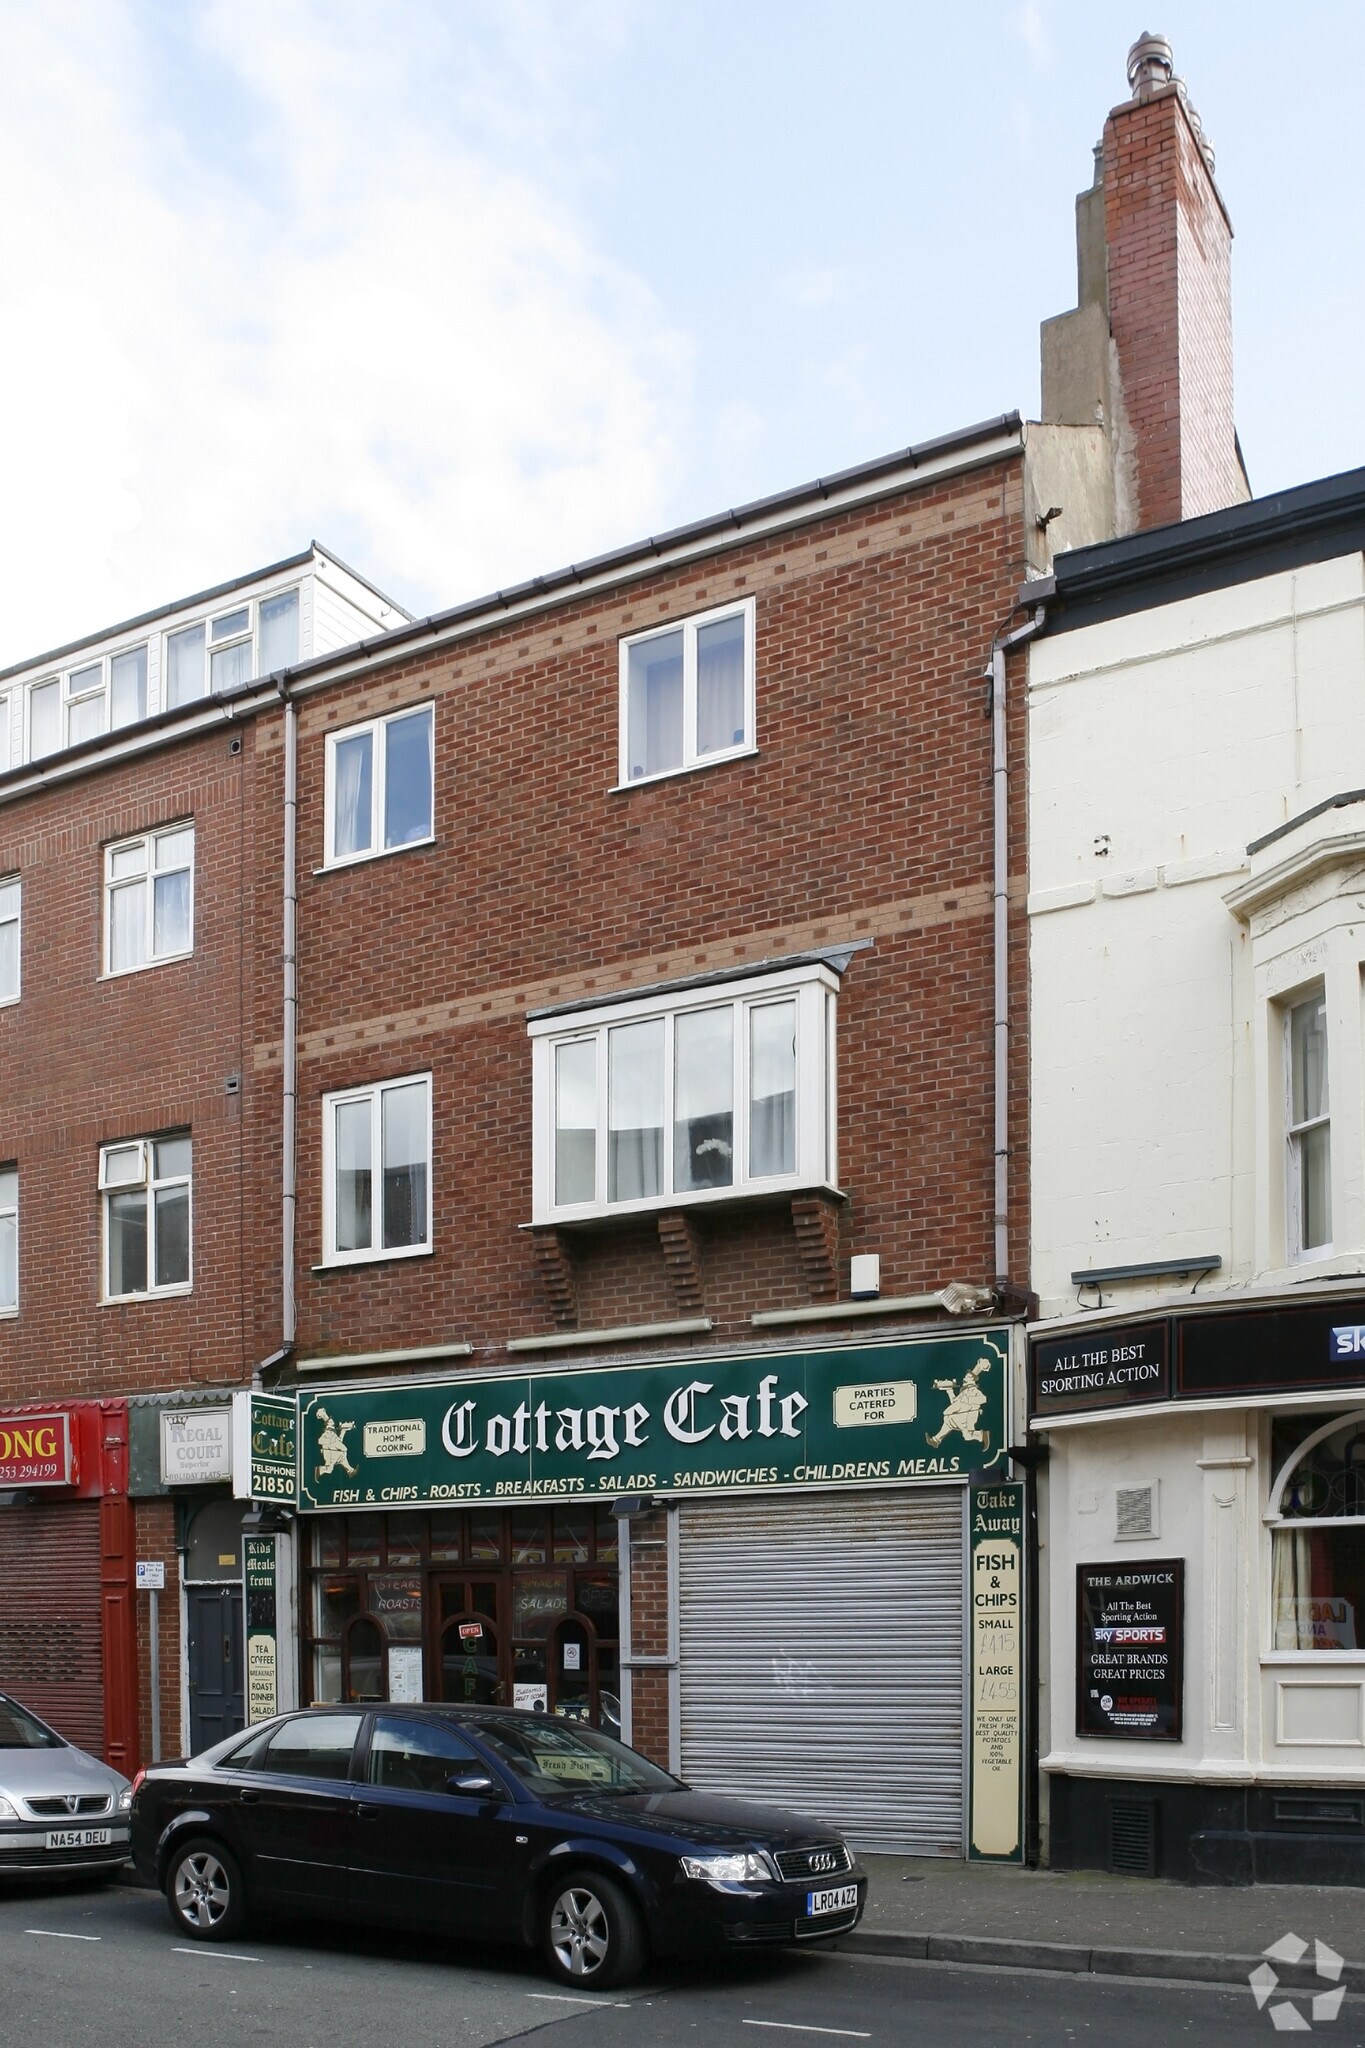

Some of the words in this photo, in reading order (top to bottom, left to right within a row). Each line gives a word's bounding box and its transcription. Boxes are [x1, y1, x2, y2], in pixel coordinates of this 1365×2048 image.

[1054, 1356, 1079, 1372] ALL
[1082, 1351, 1108, 1367] THE
[1111, 1344, 1145, 1363] BEST
[1041, 1371, 1104, 1395] SPORTING
[1106, 1363, 1160, 1384] ACTION
[854, 1386, 895, 1399] PARTIES
[849, 1398, 896, 1411] CATERED
[252, 1409, 296, 1432] Cottage
[441, 1399, 651, 1461] Cottage
[663, 1374, 809, 1445] Cafe
[864, 1410, 885, 1421] FOR
[171, 1424, 223, 1443] REGAL
[367, 1423, 422, 1435] TRADITIONAL
[252, 1430, 295, 1458] Cafe
[383, 1433, 406, 1443] HOME
[176, 1445, 223, 1460] COURT
[376, 1443, 413, 1454] COOKING
[19, 1463, 57, 1479] 294199
[180, 1461, 209, 1469] Superior
[251, 1463, 296, 1477] TELEPHONE
[169, 1472, 199, 1481] HOLIDAY
[200, 1471, 221, 1480] FLATS
[332, 1488, 360, 1503] FISH
[365, 1488, 375, 1502] &
[381, 1486, 418, 1501] CHIPS
[430, 1482, 482, 1498] ROASTS
[495, 1477, 585, 1495] BREAKFASTS
[599, 1473, 657, 1490] SALADS
[673, 1467, 778, 1486] SANDWICHES
[793, 1460, 890, 1480] CHILDRENS
[897, 1456, 960, 1475] MEALS
[253, 1475, 295, 1495] 21850
[976, 1491, 1016, 1509] Take
[973, 1514, 1021, 1534] Away
[248, 1542, 274, 1554] Kids'
[247, 1558, 276, 1570] Meals
[976, 1554, 1015, 1571] FISH
[250, 1574, 272, 1586] from
[990, 1576, 1001, 1588] &
[1087, 1576, 1112, 1587] THE
[1115, 1573, 1174, 1586] ARDWICK
[378, 1598, 422, 1610] ROASTS
[520, 1598, 567, 1610] SALADS
[975, 1593, 1017, 1607] CHIPS
[1107, 1602, 1118, 1611] All
[1120, 1601, 1134, 1611] The
[1136, 1601, 1151, 1610] Best
[1101, 1612, 1131, 1624] Sporting
[1133, 1612, 1157, 1621] Action
[979, 1620, 1014, 1629] SMALL
[462, 1627, 480, 1635] OPEN
[1095, 1629, 1113, 1642] sky
[1115, 1629, 1163, 1641] SPORTS
[255, 1645, 268, 1653] TEA
[250, 1656, 274, 1664] COFFEE
[1091, 1654, 1124, 1664] GREAT
[1127, 1654, 1168, 1664] BRANDS
[463, 1637, 478, 1704] CAF
[979, 1666, 1014, 1676] LARGE
[1093, 1669, 1127, 1680] GREAT
[1129, 1669, 1165, 1680] PRICES
[252, 1683, 273, 1691] ROAST
[251, 1693, 274, 1701] DINNER
[251, 1707, 275, 1715] SALADS
[542, 1759, 567, 1771] Fresh
[570, 1760, 590, 1773] Fish
[50, 1833, 82, 1846] NA54
[85, 1831, 107, 1844] DEU
[814, 1891, 839, 1911] LR04
[841, 1888, 856, 1906] AZZ
